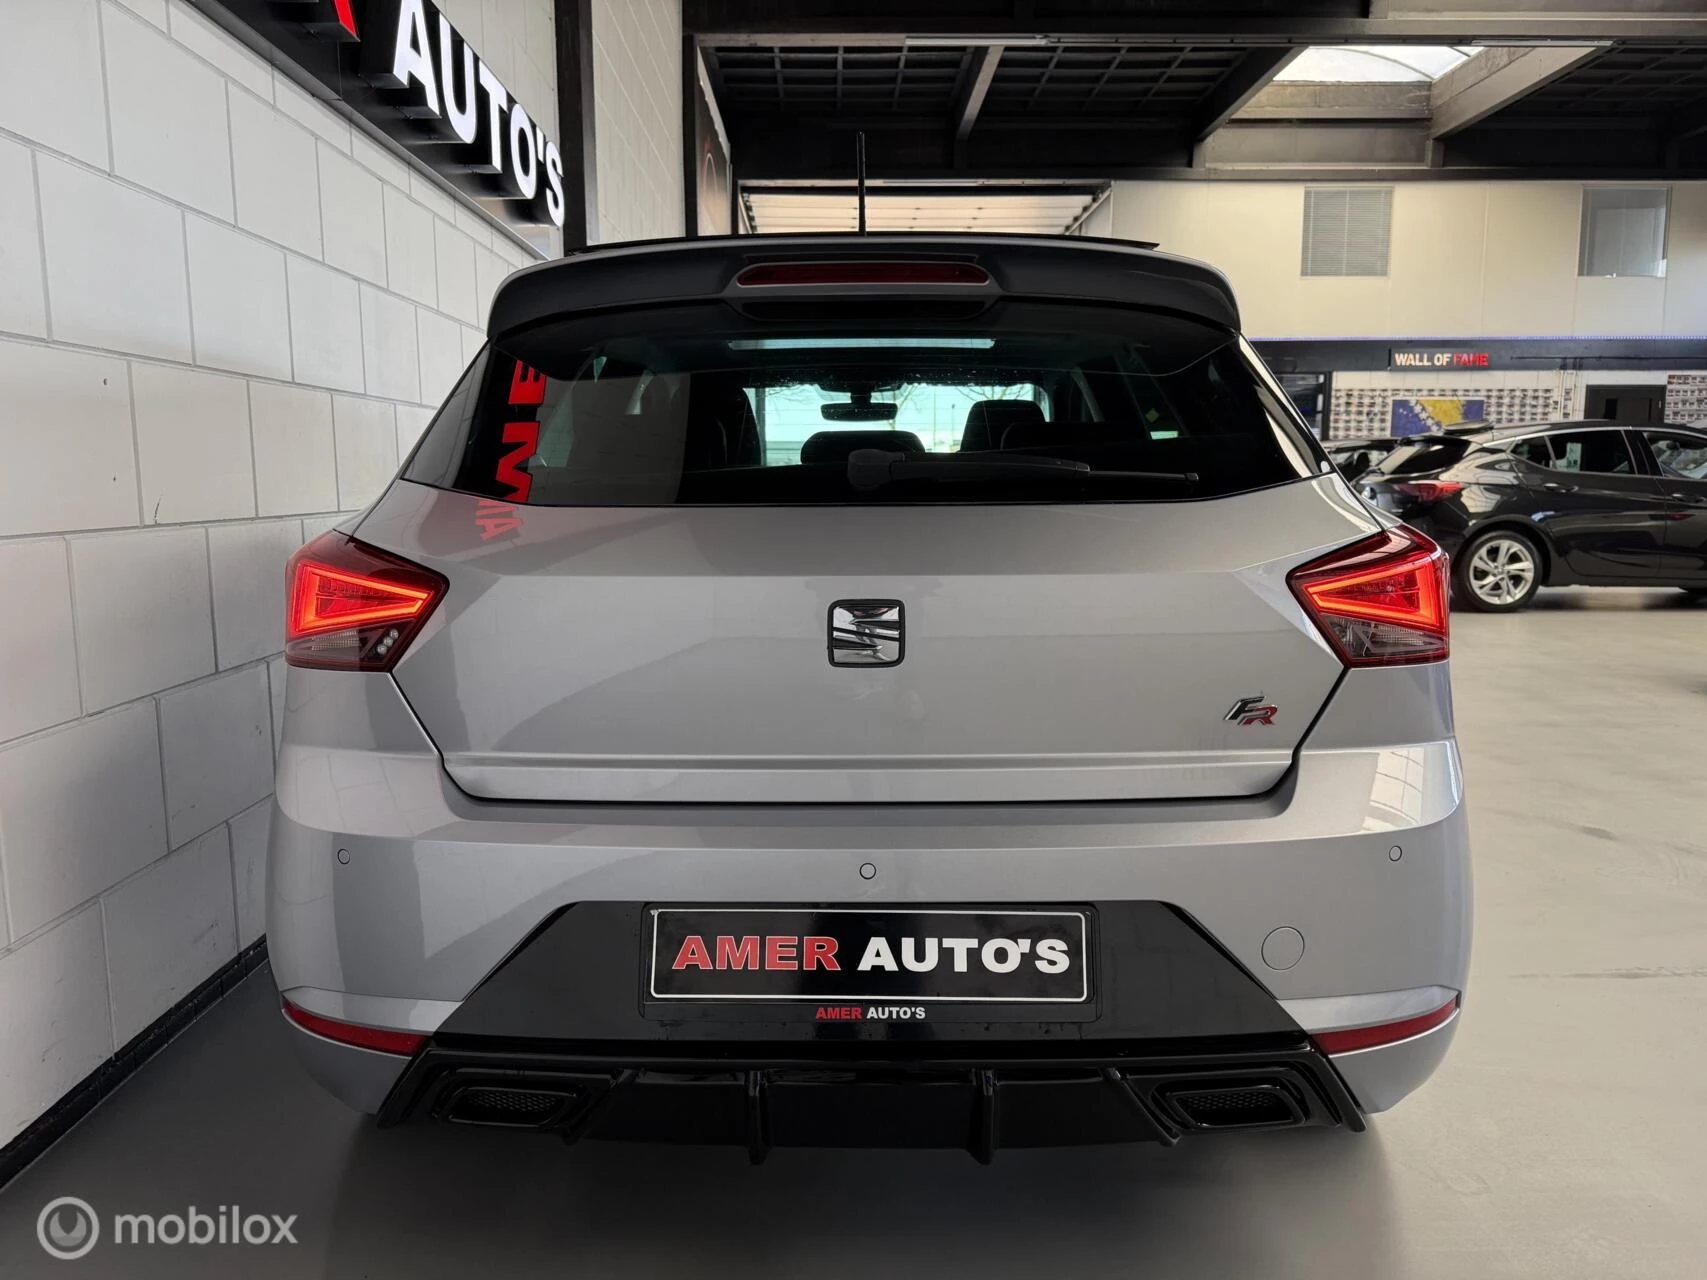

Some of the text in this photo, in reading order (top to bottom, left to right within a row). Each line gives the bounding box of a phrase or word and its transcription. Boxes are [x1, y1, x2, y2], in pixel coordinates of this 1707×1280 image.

[393, 0, 565, 228] AUTO'S
[1395, 352, 1489, 367] WALL OF FAME
[671, 935, 1071, 974] AMER AUTO'S
[815, 1006, 926, 1020] AMER AUTO'S
